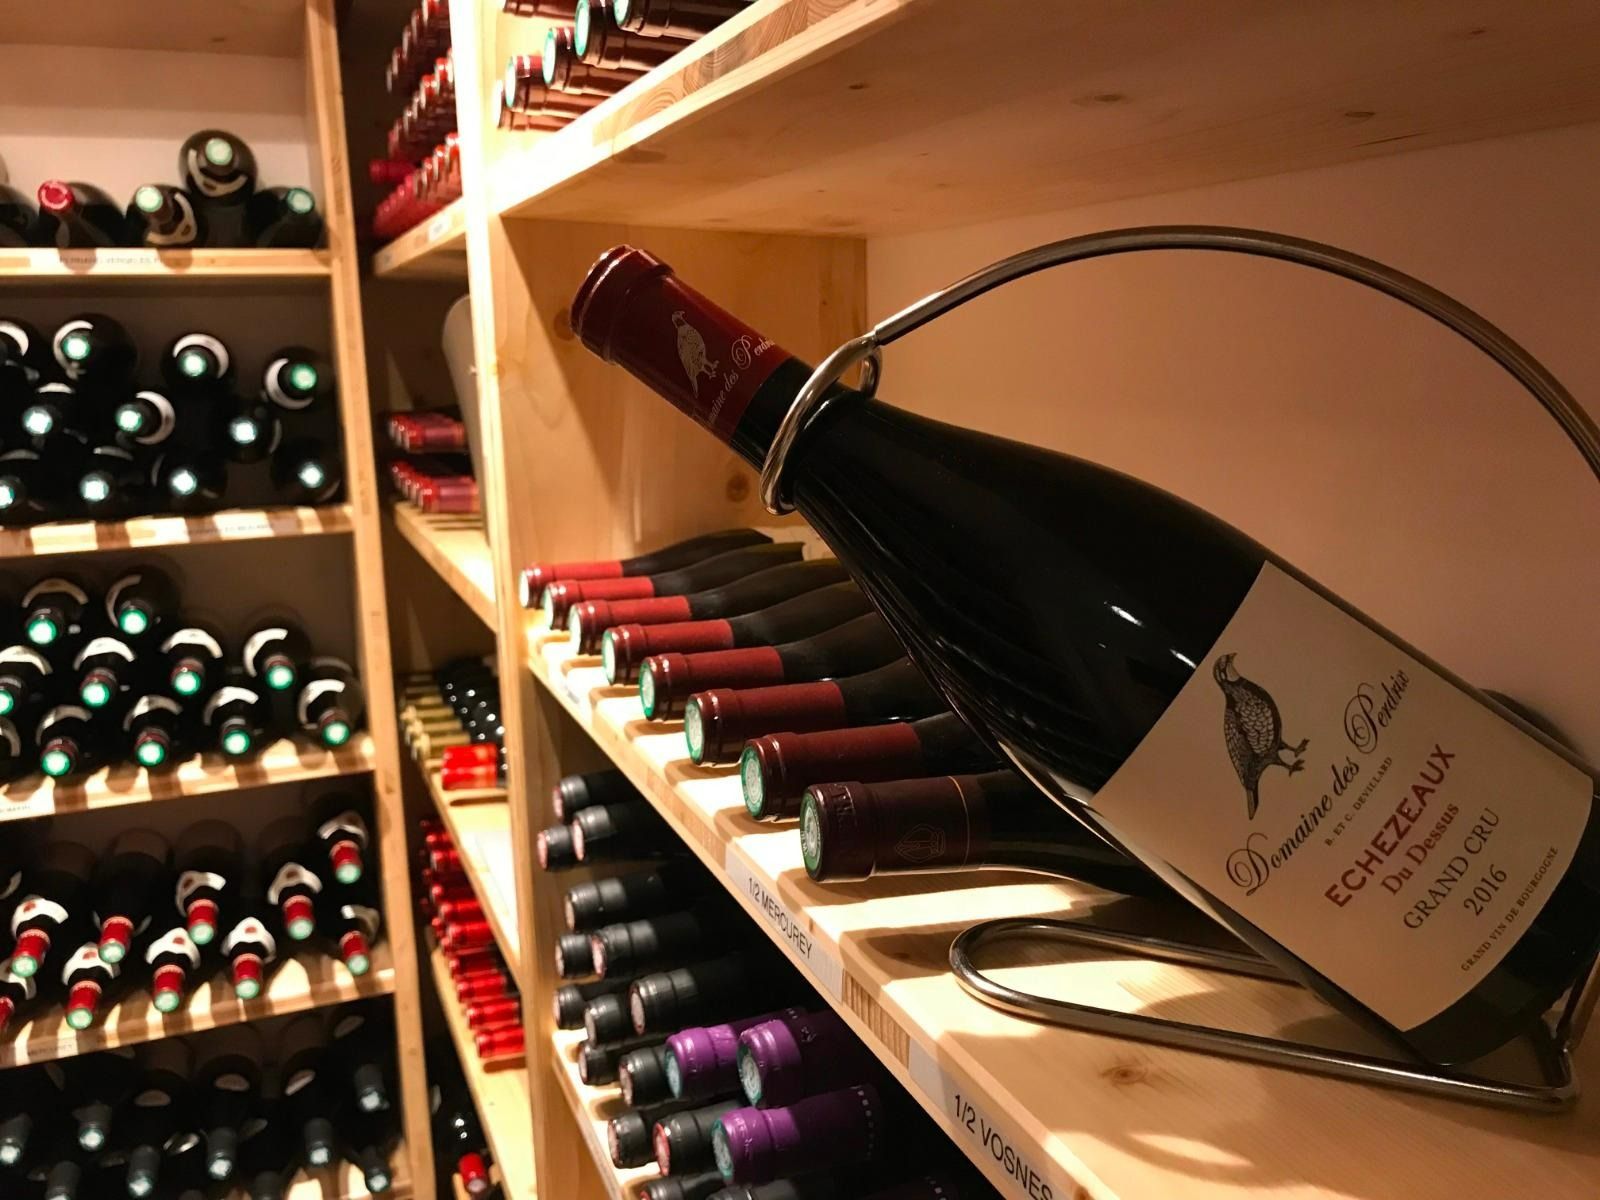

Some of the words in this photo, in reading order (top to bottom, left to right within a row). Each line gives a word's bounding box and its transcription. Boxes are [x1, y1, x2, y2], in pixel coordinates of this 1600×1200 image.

[1344, 669, 1410, 754] Perdrix
[1325, 837, 1334, 847] B.
[1334, 822, 1346, 836] ET
[1345, 811, 1356, 823] C.
[1355, 756, 1393, 811] DEVILLARD
[1331, 756, 1360, 797] des
[1226, 794, 1333, 896] Domaine
[1324, 743, 1456, 908] ECHEZEAUX
[1380, 870, 1414, 896] Du
[1406, 803, 1460, 866] Dessus
[1403, 855, 1469, 929] GRAND
[1463, 807, 1500, 855] CRU
[748, 877, 761, 904] 1/2
[761, 890, 812, 960] MERCUREY
[1461, 940, 1492, 972] GRAND
[1490, 921, 1508, 942] VIN
[1505, 907, 1520, 923] DE
[1517, 845, 1559, 907] BOURGOGNE
[1463, 864, 1508, 916] 2016
[955, 1094, 976, 1134] 1/2
